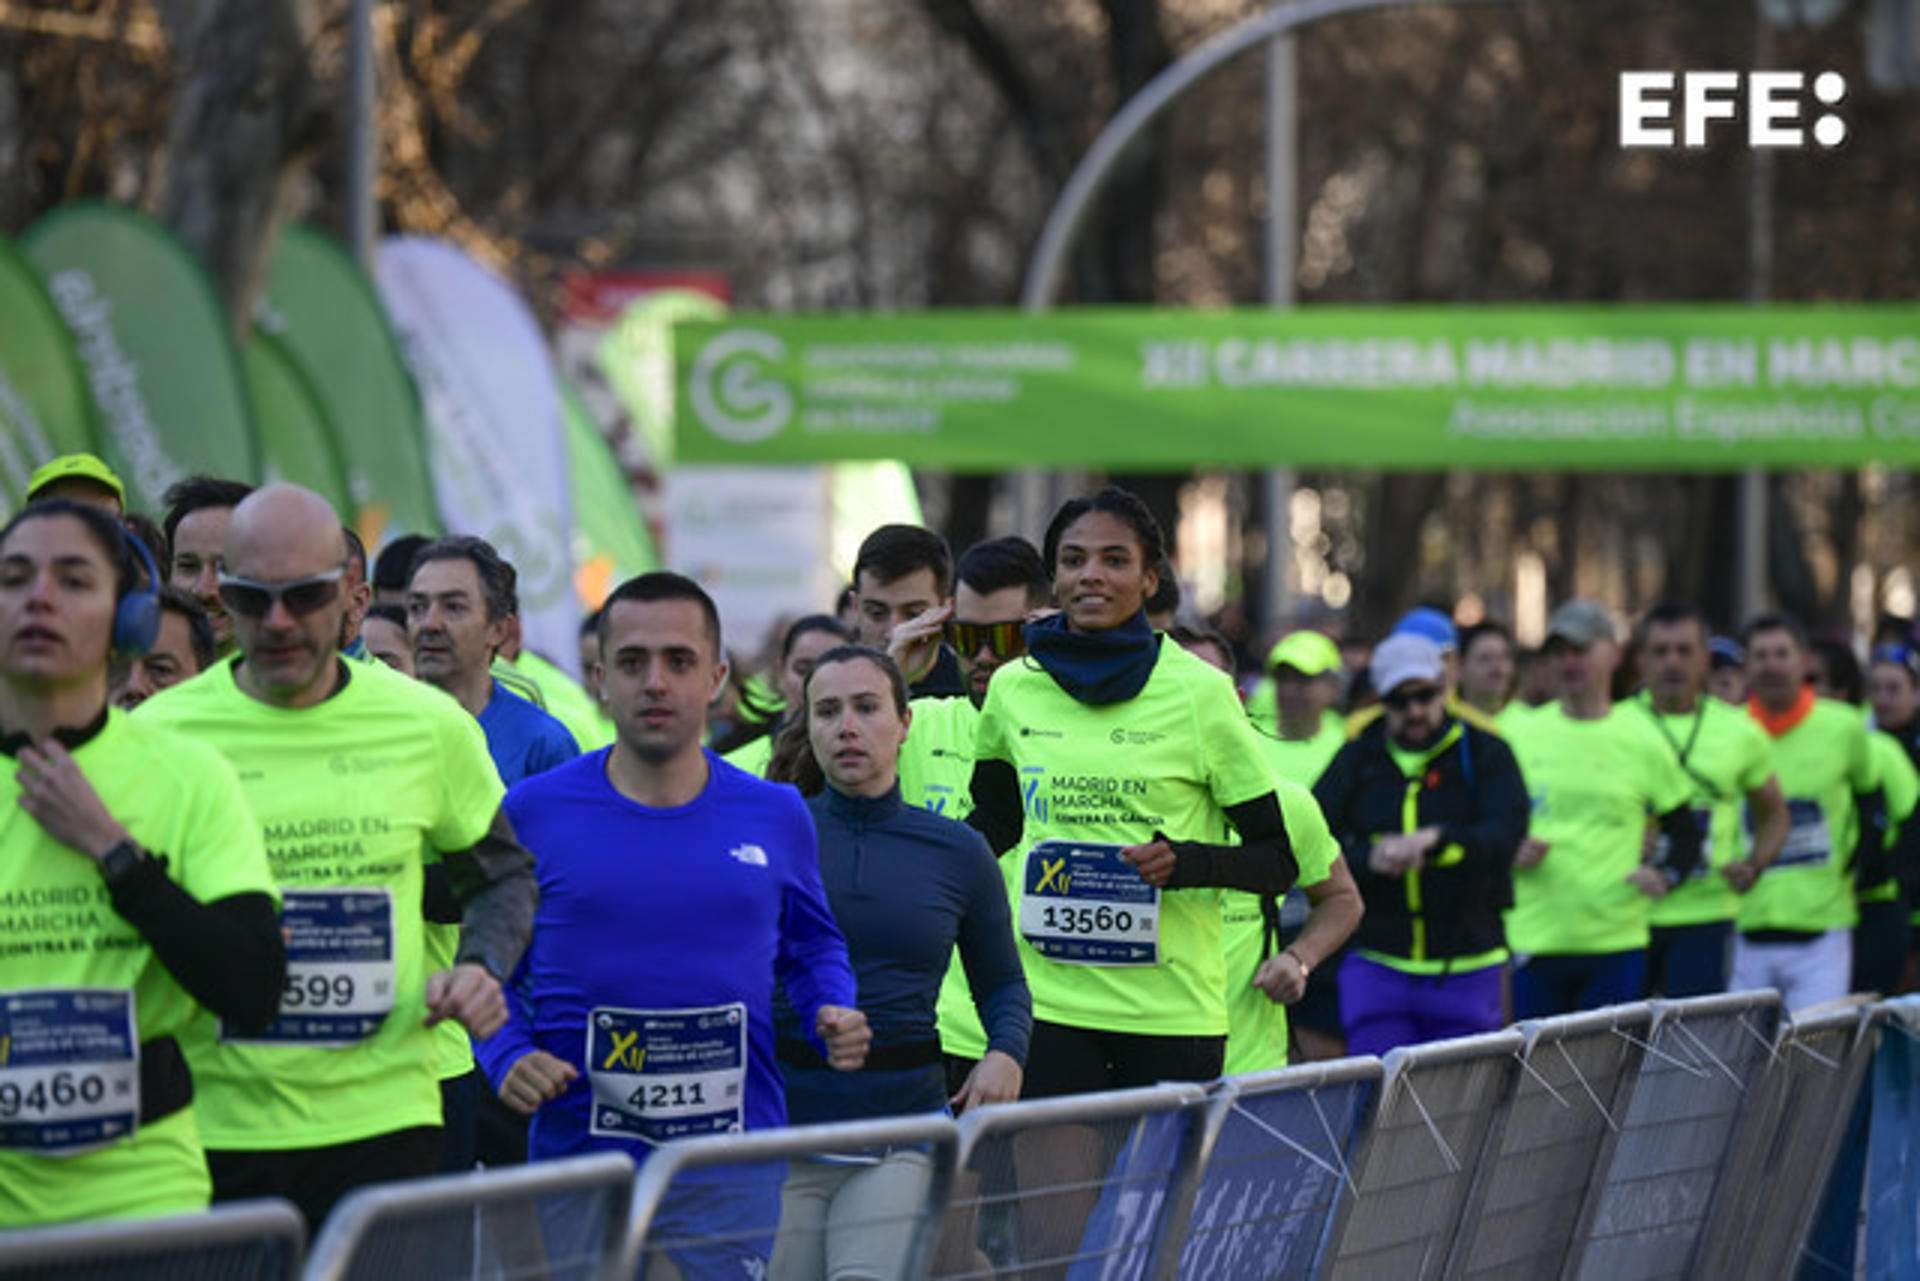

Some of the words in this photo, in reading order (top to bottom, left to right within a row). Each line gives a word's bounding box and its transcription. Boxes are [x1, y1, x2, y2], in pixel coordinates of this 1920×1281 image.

[1215, 336, 1457, 388] CARRERA
[1464, 336, 1676, 388] MADRID
[1684, 338, 1758, 387] EN
[1052, 776, 1119, 793] MADRID
[1122, 780, 1147, 795] EN
[1052, 795, 1124, 809] MARCHA
[264, 818, 355, 843] MADRID
[360, 816, 390, 835] EN
[266, 841, 364, 864] MARCHA
[1043, 905, 1133, 934] 13560
[0, 1071, 105, 1118] 9460
[628, 1082, 706, 1112] 4211
